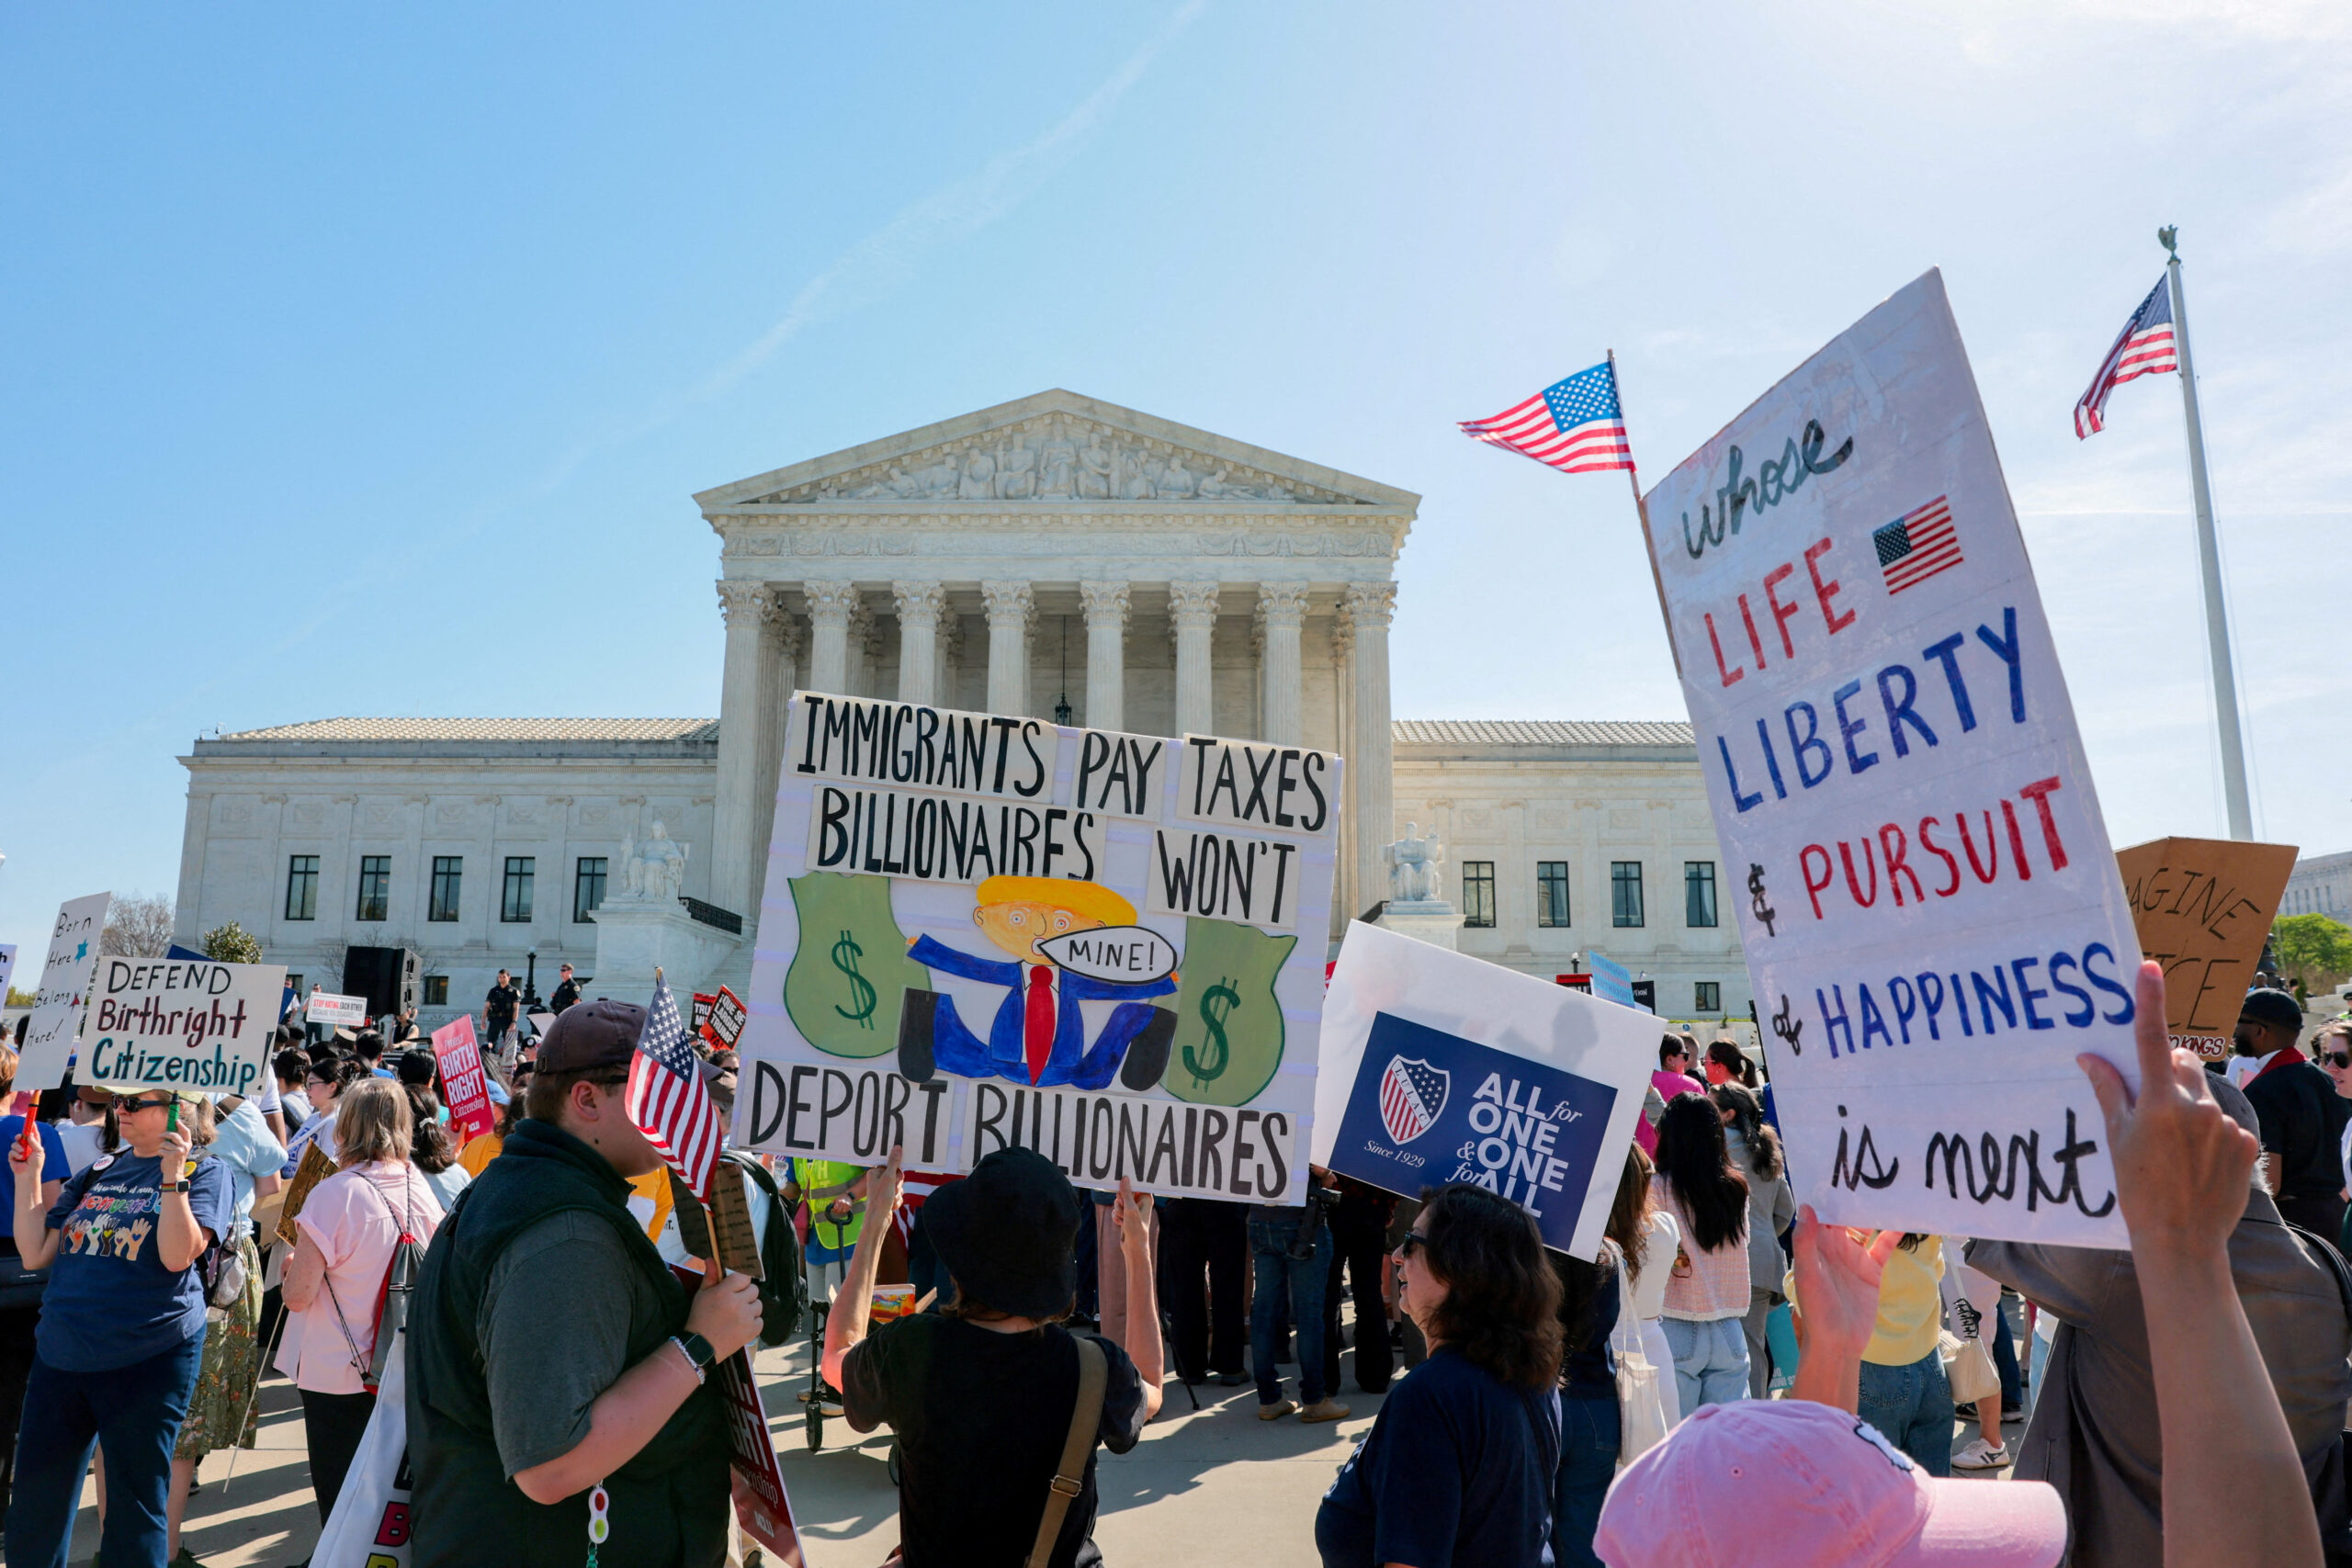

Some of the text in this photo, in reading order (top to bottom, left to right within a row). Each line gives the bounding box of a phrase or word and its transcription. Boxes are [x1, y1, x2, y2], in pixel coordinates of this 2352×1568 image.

[1681, 419, 1854, 559] whose
[1704, 536, 1857, 688] LIFE
[1717, 606, 2027, 813] LIBERTY
[797, 695, 1327, 832] IMMIGRANTS PAY TAXES
[817, 787, 1295, 923] BILLIONAIRES WON'T
[1799, 775, 2069, 920] PURSUIT
[56, 913, 92, 939] Born
[2125, 867, 2261, 941] AGINE
[47, 950, 72, 970] Here
[107, 961, 232, 995] DEFEND
[1069, 939, 1155, 974] MINE!
[34, 987, 70, 1010] Belong
[339, 1001, 350, 1010] EACH
[350, 1003, 363, 1011] OTHER
[695, 1003, 711, 1016] TRU
[734, 1010, 746, 1026] SE
[1634, 988, 1647, 997] TION
[1771, 942, 2135, 1059] of HAPPINESS
[26, 1019, 63, 1046] Here!
[96, 995, 247, 1048] Birthright
[710, 1013, 734, 1043] TRUMP
[714, 1003, 741, 1036] LARGUE
[2181, 1035, 2224, 1055] KINGS
[91, 1032, 275, 1095] Citizenship!
[440, 1042, 477, 1080] BIRTH
[446, 1068, 483, 1106] RIGHT
[453, 1095, 486, 1119] Citizenship
[1395, 1067, 1428, 1122] LULAC
[1472, 1072, 1582, 1123] ALL for
[749, 1059, 1288, 1198] DEPORT BILLIONAIRES
[1364, 1139, 1426, 1168] Since 1929
[1468, 1101, 1560, 1156] ONE
[1456, 1137, 1569, 1192] & ONE
[1831, 1104, 2116, 1217] is next
[1444, 1162, 1543, 1218] for ALL
[727, 1399, 769, 1472] GHT
